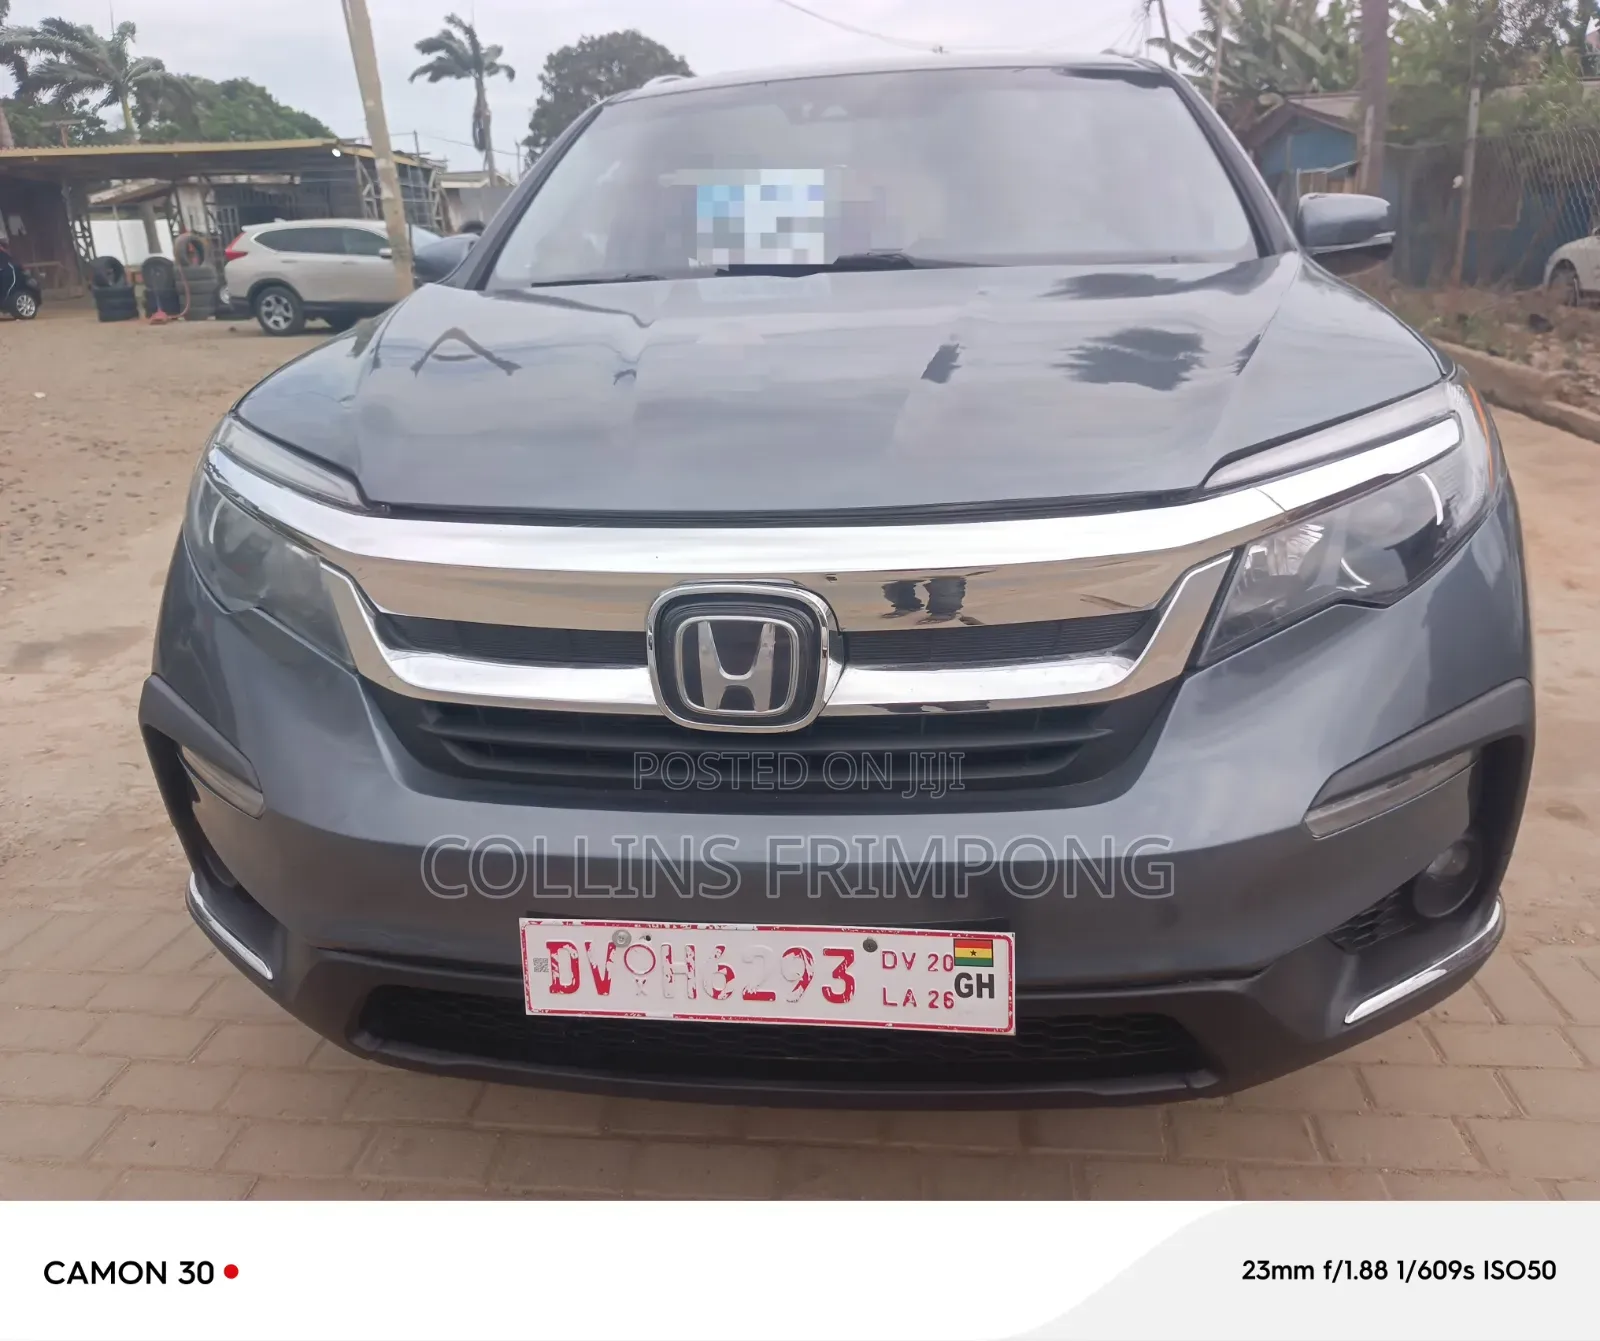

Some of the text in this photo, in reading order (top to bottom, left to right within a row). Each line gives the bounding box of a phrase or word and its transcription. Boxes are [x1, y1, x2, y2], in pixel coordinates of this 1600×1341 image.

[545, 941, 856, 1005] DV H6293
[881, 950, 955, 972] DV 20
[954, 972, 995, 999] GH
[882, 987, 955, 1009] LA 26
